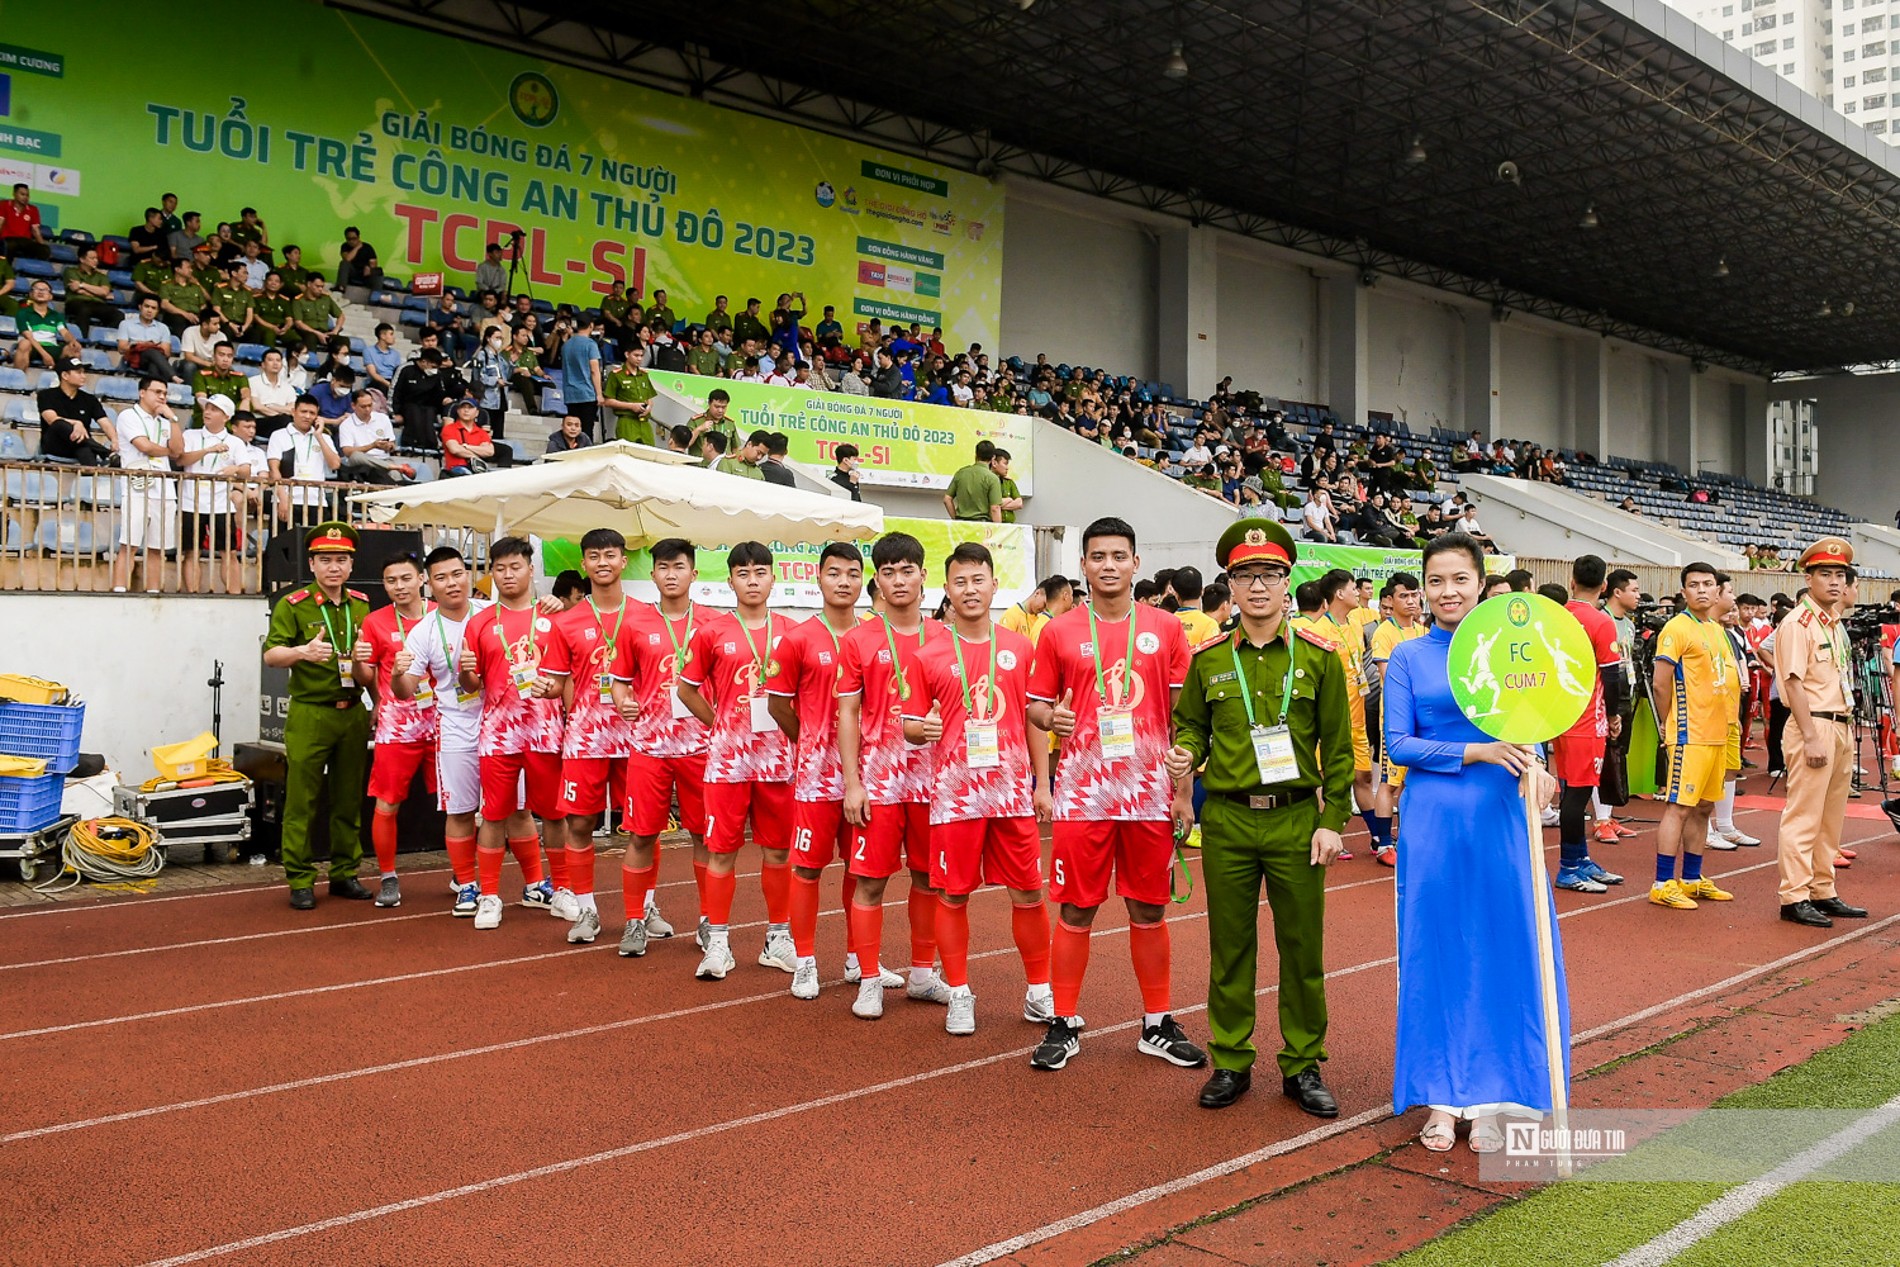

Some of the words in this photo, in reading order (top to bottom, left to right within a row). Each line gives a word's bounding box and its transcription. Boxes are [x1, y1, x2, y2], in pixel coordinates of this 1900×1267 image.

[16, 135, 42, 150] BẠC
[381, 110, 441, 145] GIẢI
[450, 124, 528, 163] BÓNG
[535, 143, 572, 173] ĐÁ
[579, 153, 595, 176] 7
[600, 157, 677, 196] NGƯỜI
[146, 96, 270, 164] TUỔI
[285, 131, 378, 184] TRẺ
[391, 149, 510, 208] CÔNG
[521, 179, 578, 222] AN
[590, 192, 665, 237] THỦ
[675, 208, 724, 249] ĐÔ
[734, 222, 816, 266] 2023
[806, 397, 825, 411] GIẢI
[827, 400, 852, 415] BÓNG
[854, 403, 867, 416] ĐÁ
[868, 405, 874, 417] 7
[876, 405, 903, 420] NGƯỜI
[740, 403, 775, 427] TUỔI
[779, 411, 806, 430] TRẺ
[810, 415, 847, 434] CÔNG
[850, 421, 870, 437] AN
[873, 421, 899, 439] THỦ
[902, 424, 921, 441] ĐÔ
[923, 429, 955, 445] 2023
[1510, 642, 1532, 663] FC
[1504, 674, 1537, 693] CỤM
[1539, 672, 1547, 686] 7
[564, 779, 578, 802] 15
[794, 826, 812, 852] 16
[854, 836, 866, 861] 2
[939, 851, 948, 876] 4
